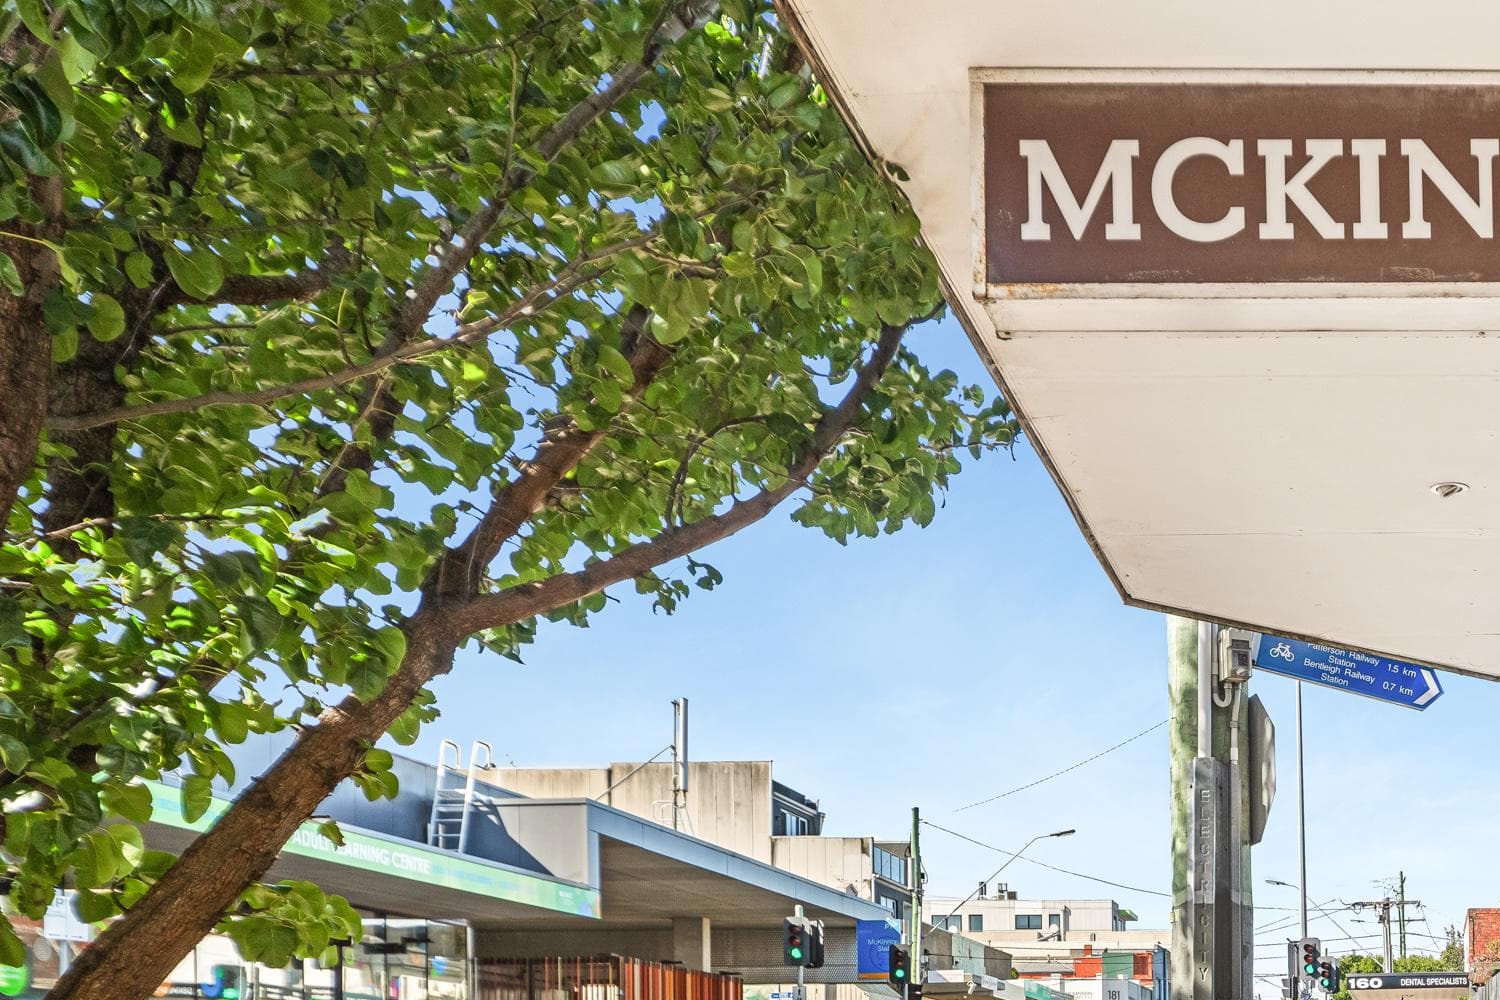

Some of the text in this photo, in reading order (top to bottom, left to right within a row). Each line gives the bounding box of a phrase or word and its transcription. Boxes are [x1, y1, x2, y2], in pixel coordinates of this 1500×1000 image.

[1328, 656, 1356, 668] Station
[1304, 659, 1413, 696] Bentleigh Railway 0.7 km
[1402, 667, 1417, 678] km
[1321, 673, 1349, 686] Station
[1348, 976, 1467, 989] 160 DENTAL SPECIALISTS
[1107, 990, 1121, 1000] 181
